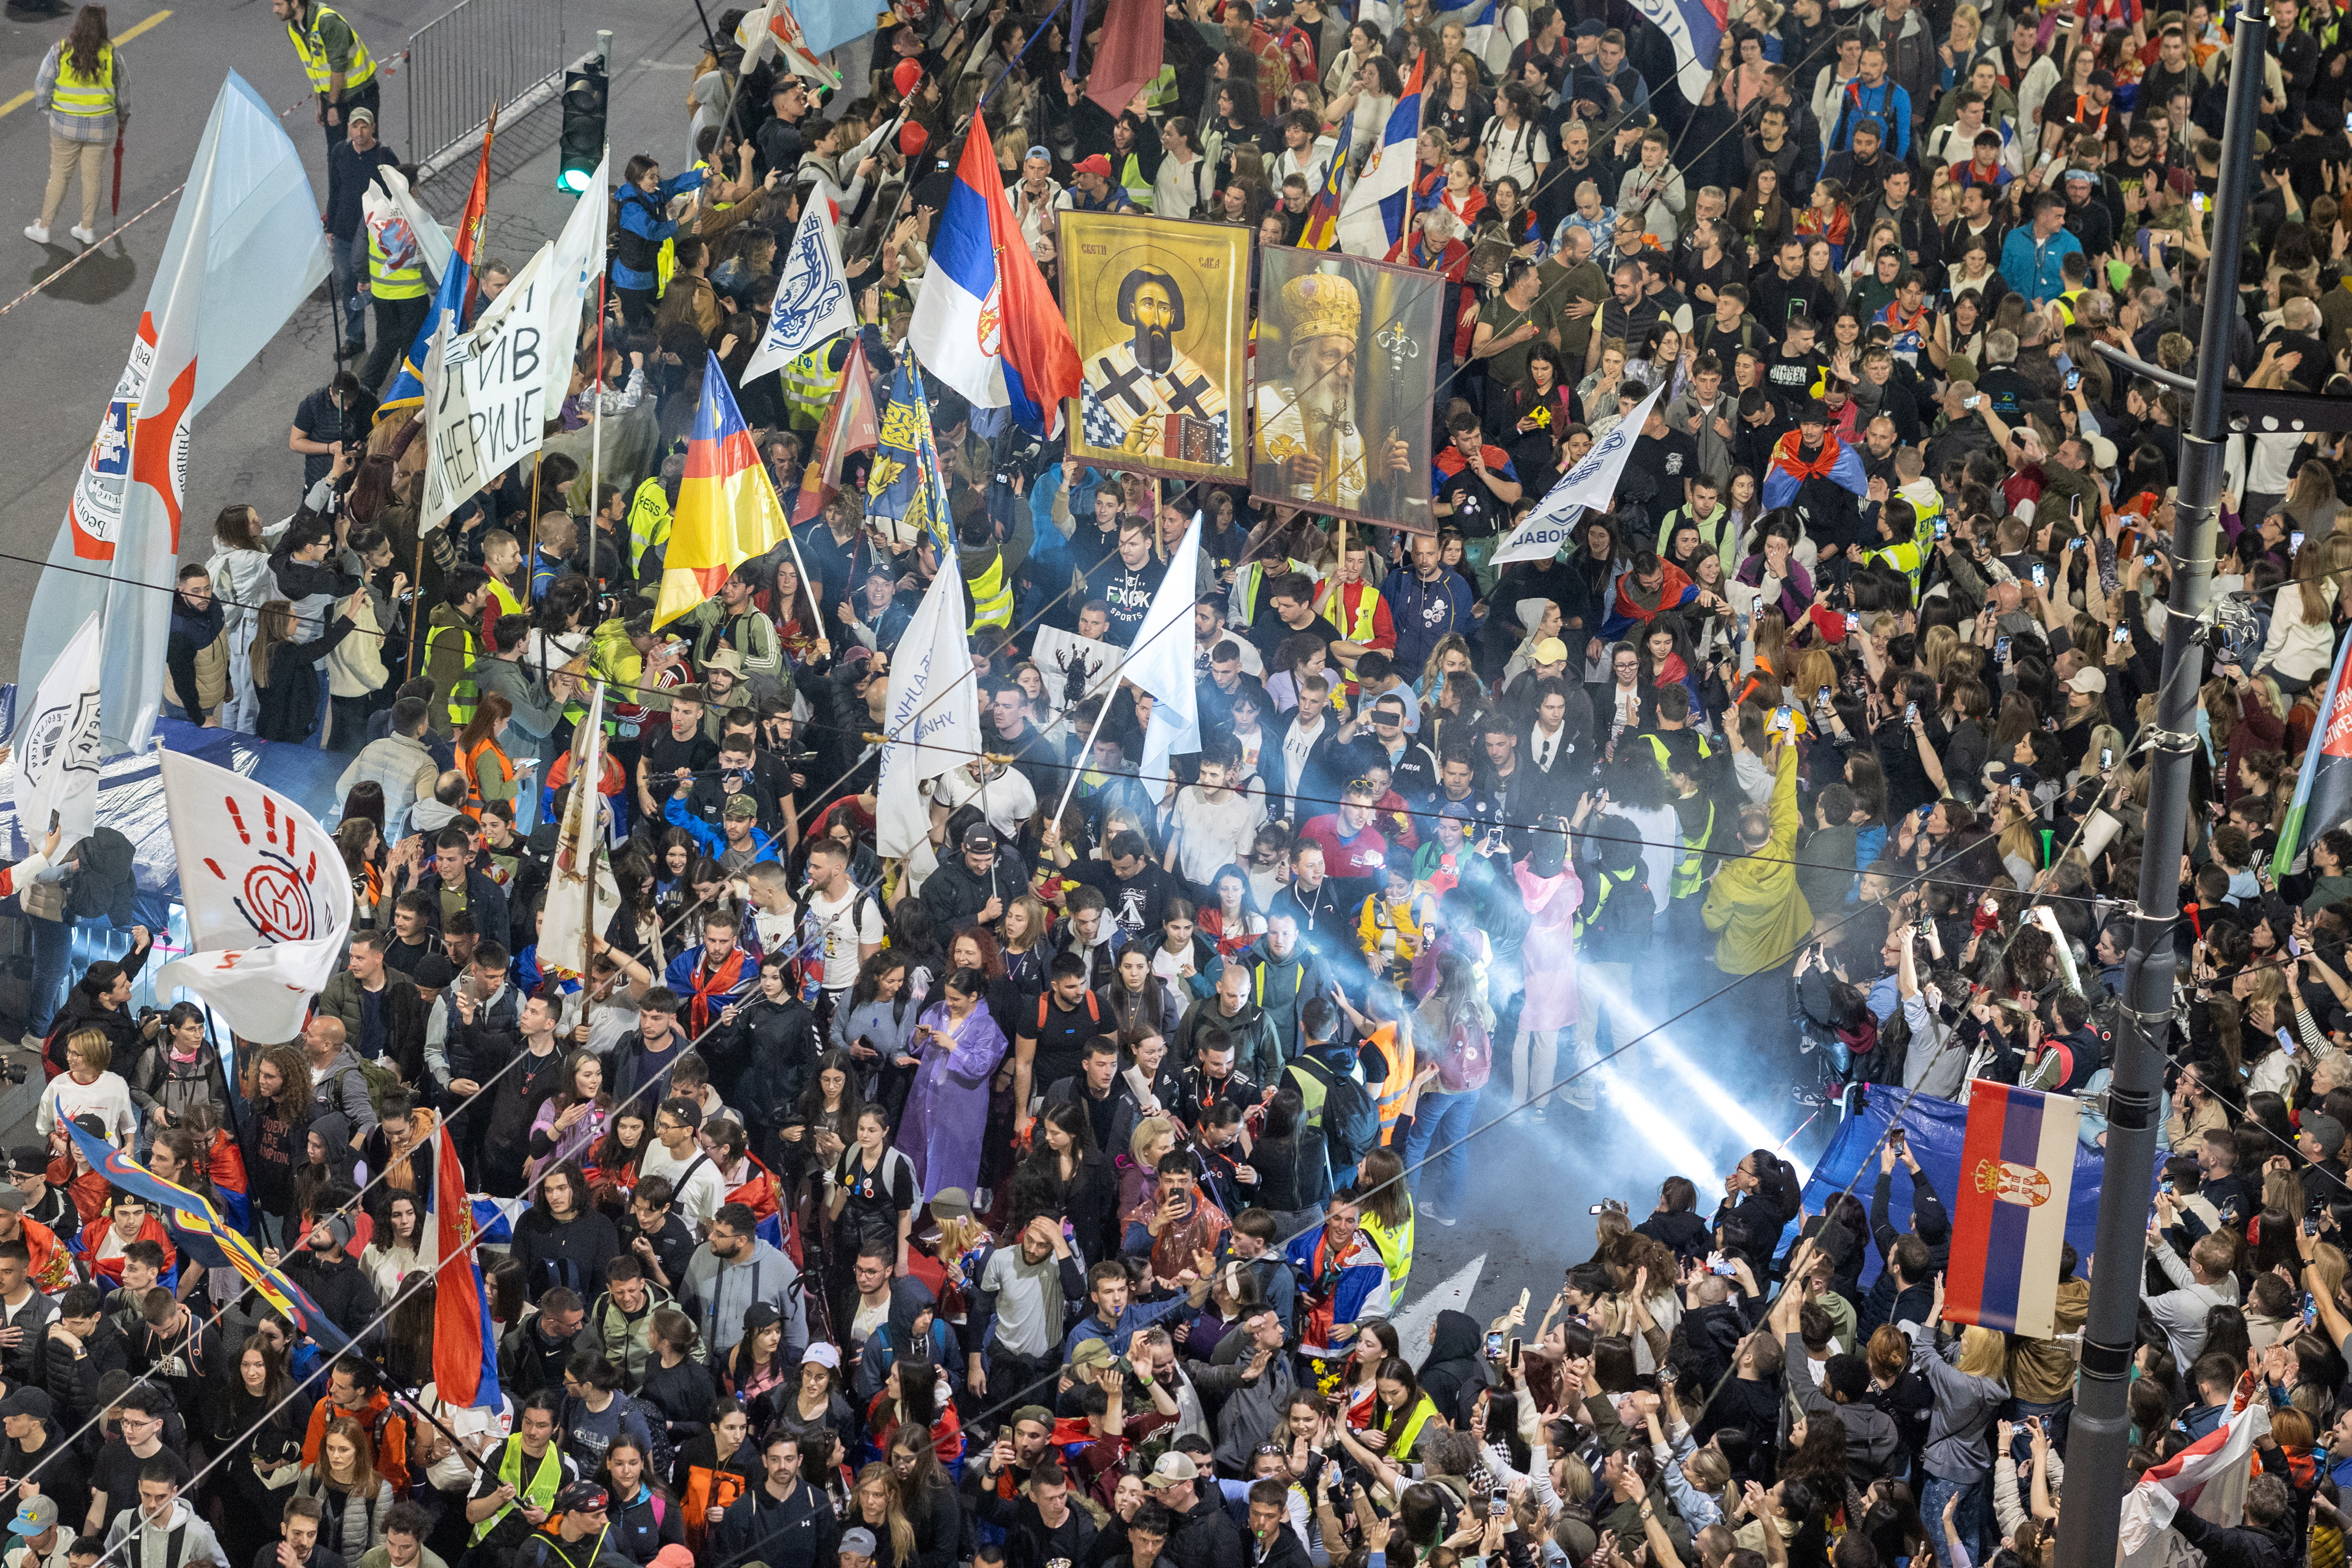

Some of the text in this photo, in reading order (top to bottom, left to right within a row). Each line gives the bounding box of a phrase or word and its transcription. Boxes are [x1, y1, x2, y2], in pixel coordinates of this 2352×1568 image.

[638, 495, 660, 516] RESS
[1110, 607, 1143, 621] SPORTS
[1401, 763, 1421, 772] PUMA
